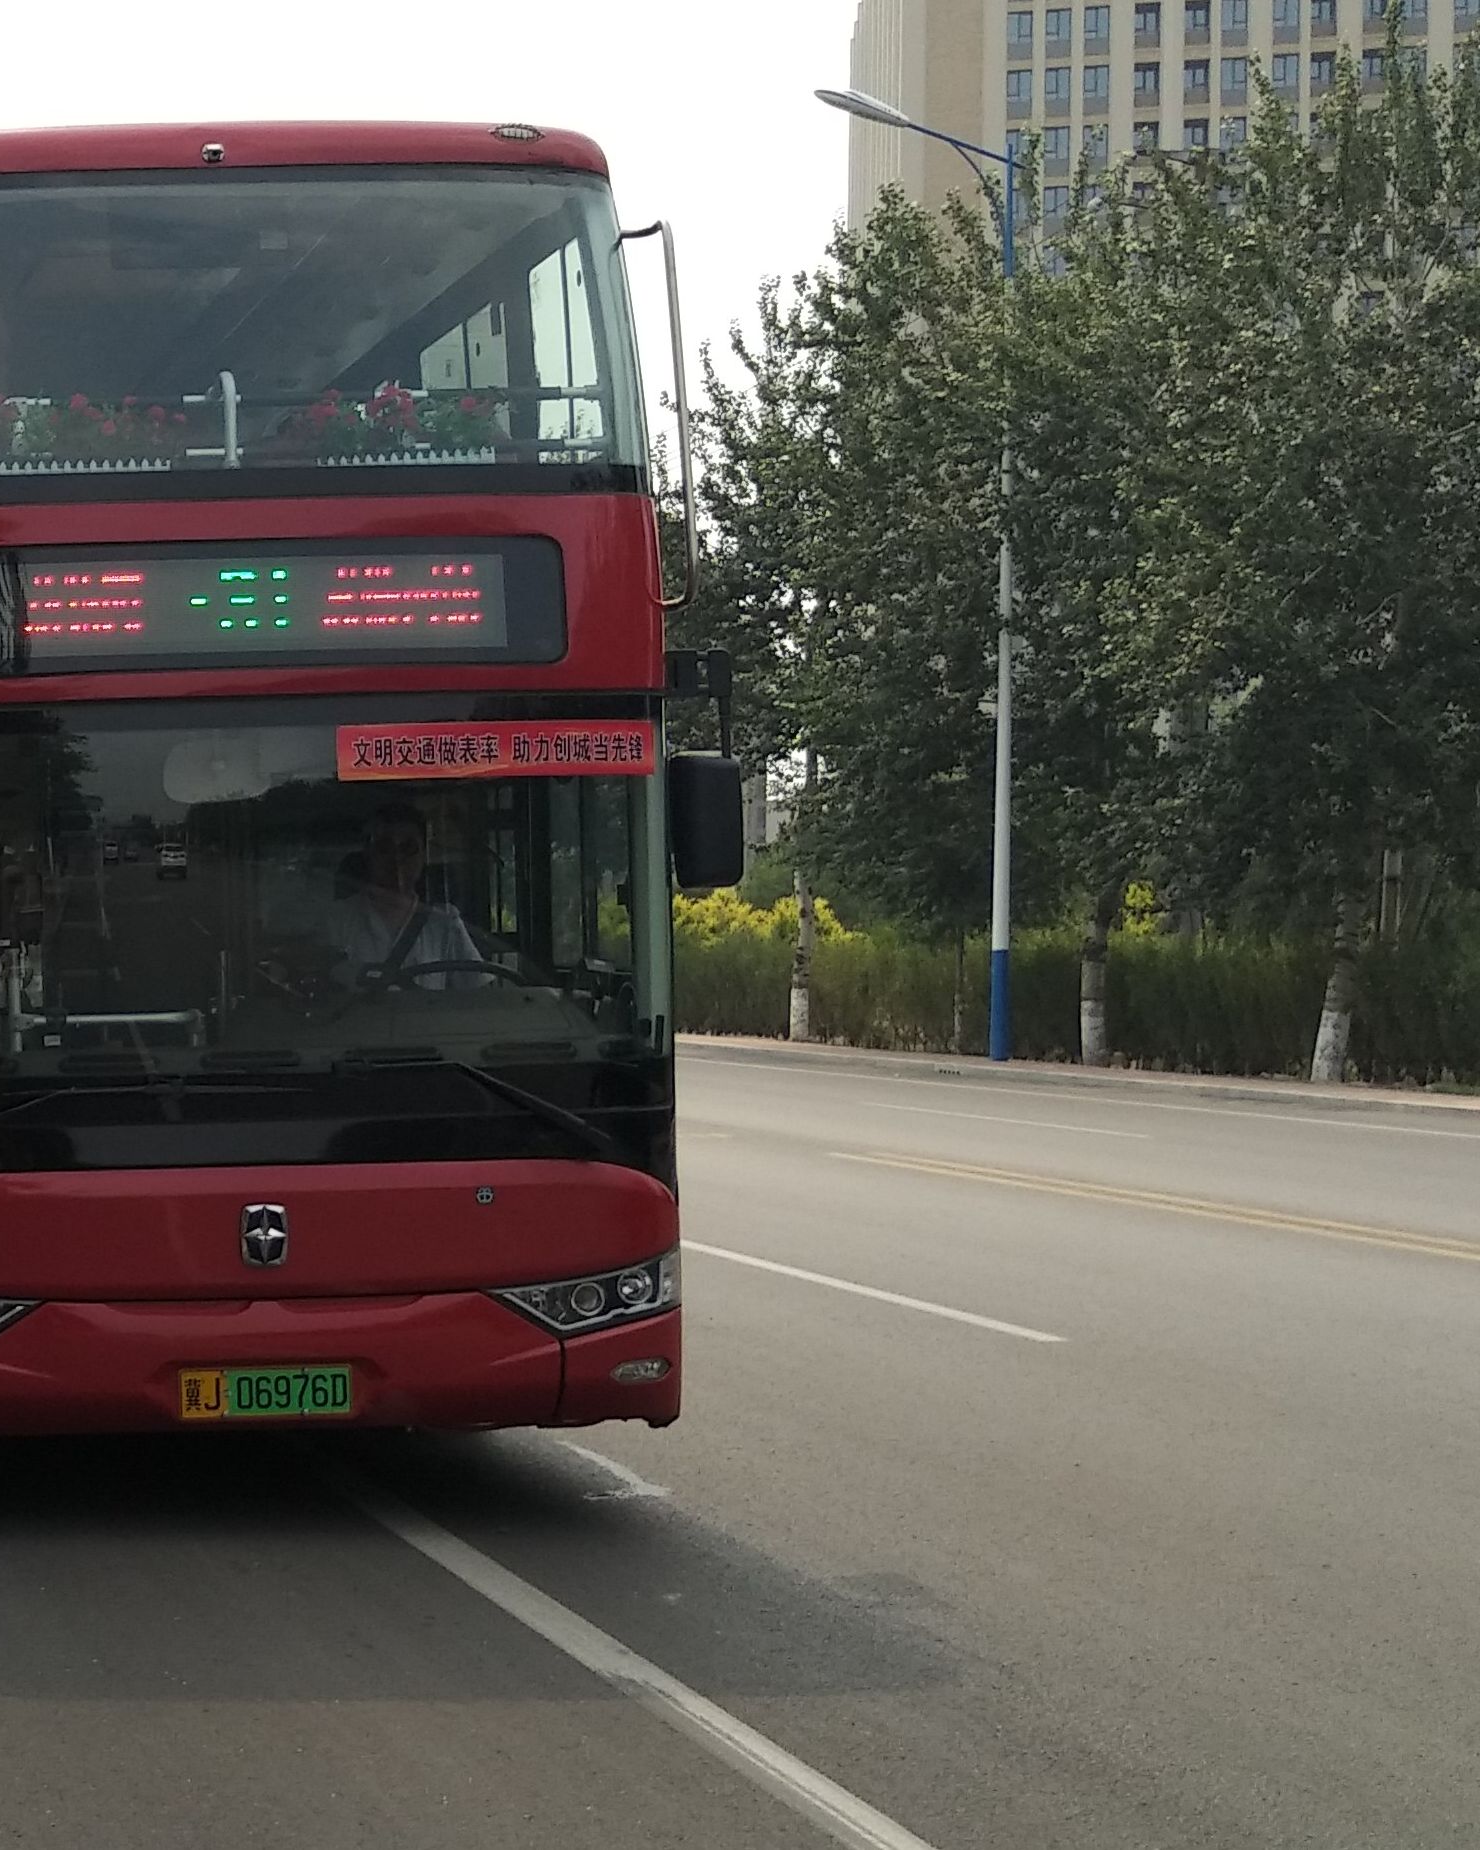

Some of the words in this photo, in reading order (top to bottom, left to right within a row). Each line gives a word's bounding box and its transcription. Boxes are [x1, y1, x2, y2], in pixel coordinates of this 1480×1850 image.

[353, 734, 499, 767] 文明交通做表率
[512, 733, 643, 763] 助力创城当先锋
